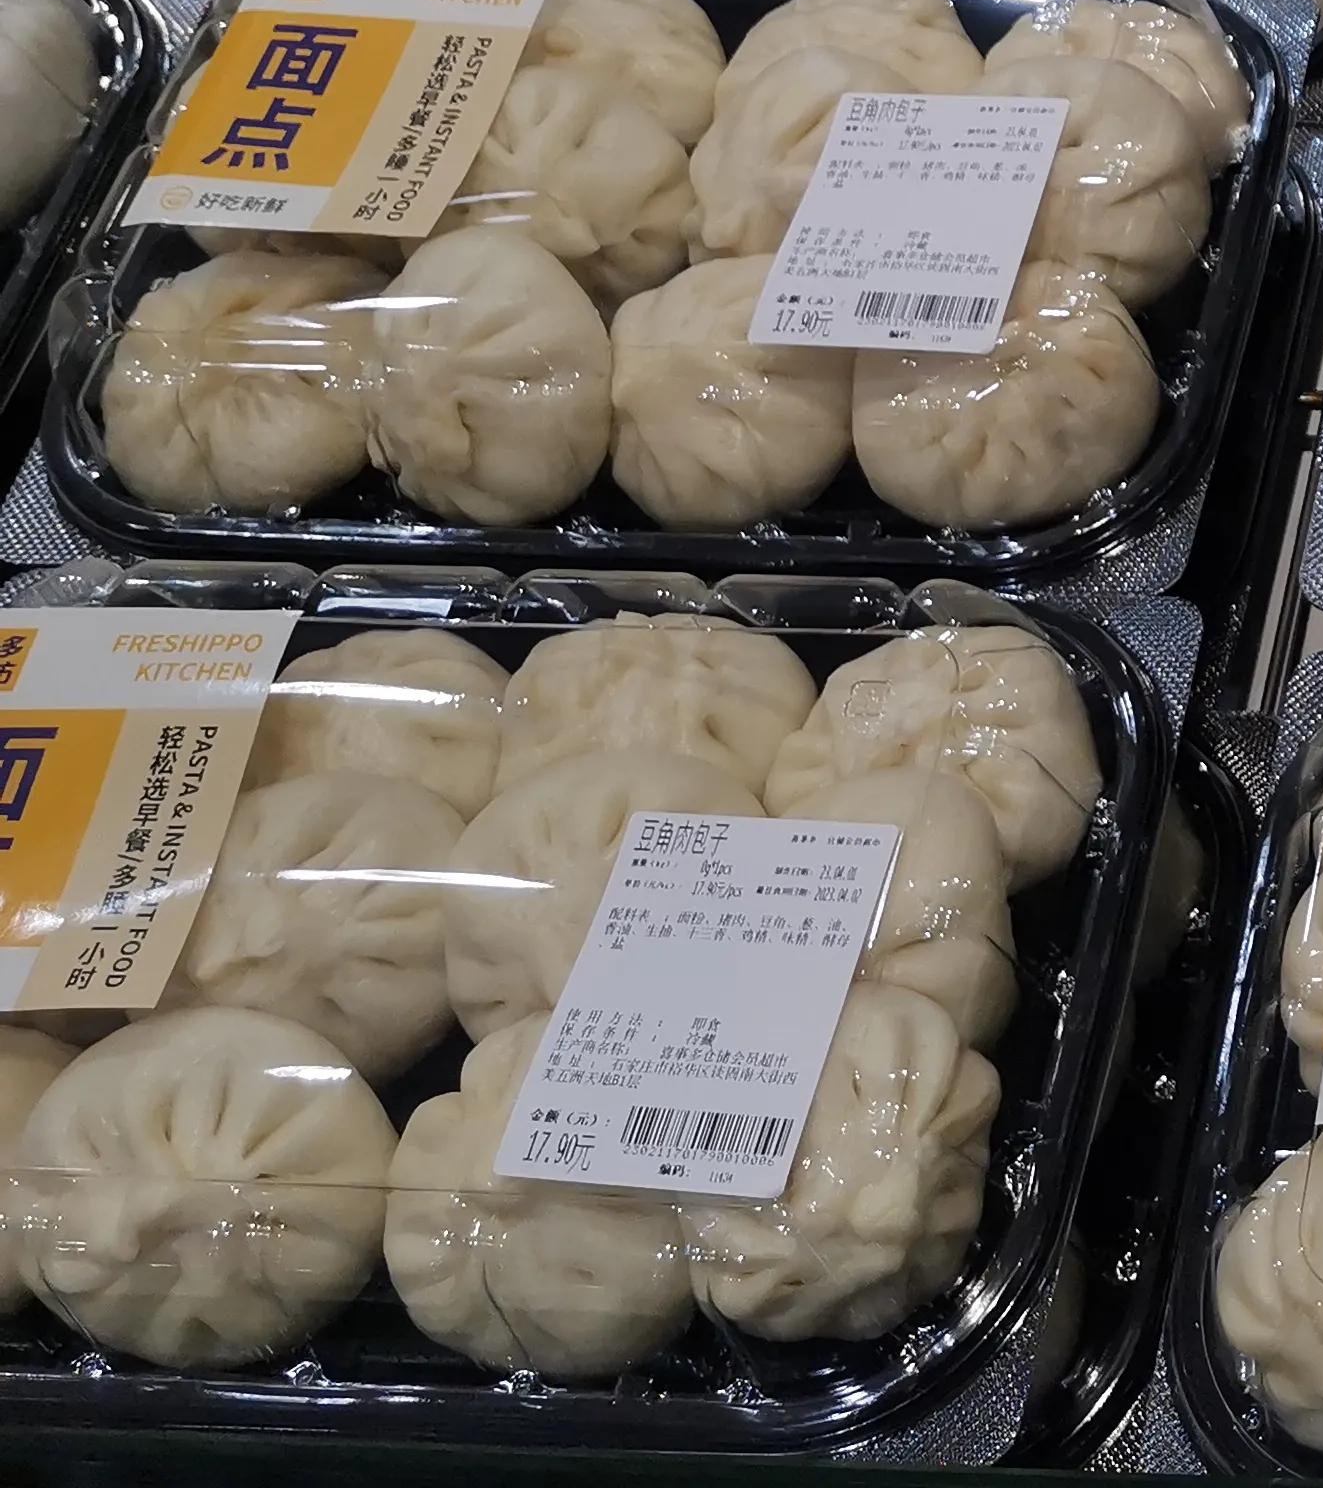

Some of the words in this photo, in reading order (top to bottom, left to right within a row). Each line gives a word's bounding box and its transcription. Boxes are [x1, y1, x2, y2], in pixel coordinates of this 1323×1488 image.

[454, 37, 492, 92] PASTA
[201, 24, 358, 171] 面点
[416, 108, 460, 184] INSTANT
[386, 179, 421, 222] FOOD
[772, 309, 833, 338] 17.90元
[112, 634, 265, 653] FRESHIPPO
[134, 662, 253, 682] KITCHEN
[178, 725, 218, 797] PASTA
[633, 819, 731, 857] 豆角肉包子
[104, 926, 149, 989] FOOD
[523, 1130, 597, 1174] 17.90元
